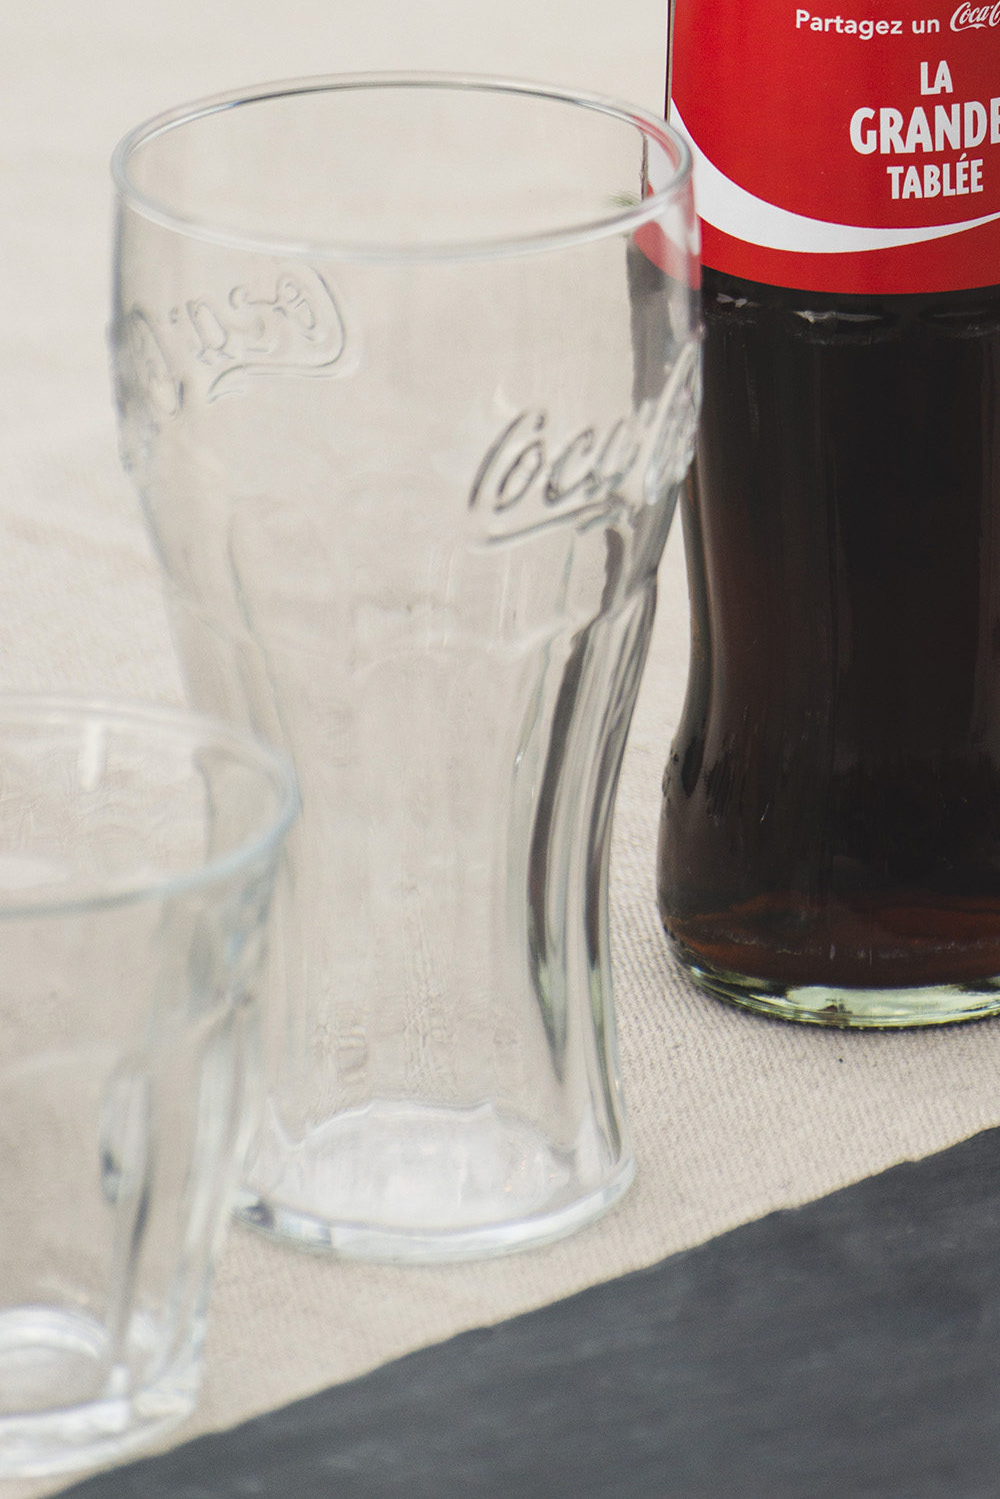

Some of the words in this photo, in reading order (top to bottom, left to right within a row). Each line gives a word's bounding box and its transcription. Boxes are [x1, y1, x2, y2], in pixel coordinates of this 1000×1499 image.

[795, 9, 903, 40] Partagez
[911, 18, 940, 34] un
[920, 60, 953, 95] LA
[886, 152, 984, 200] TABLÉE
